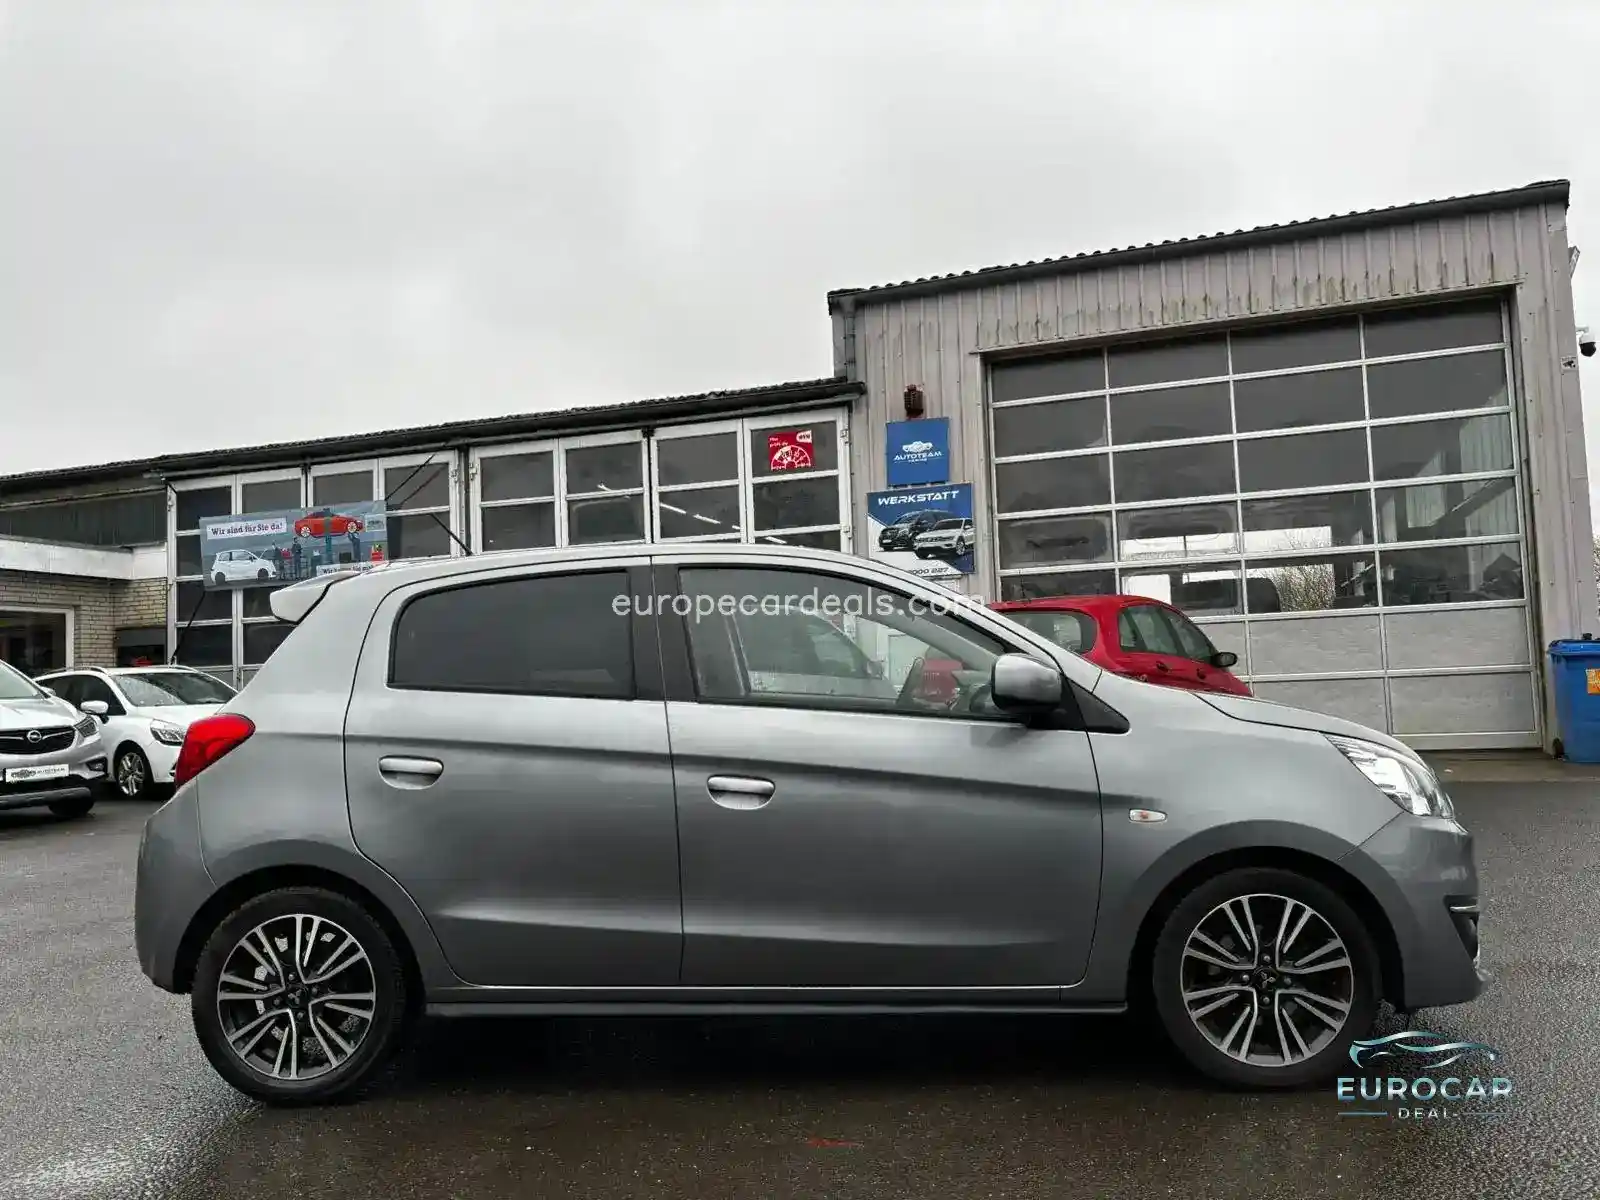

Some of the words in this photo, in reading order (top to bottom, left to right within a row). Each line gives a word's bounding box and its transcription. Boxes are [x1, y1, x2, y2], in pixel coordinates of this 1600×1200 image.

[893, 451, 943, 460] AUTOTEAM
[878, 490, 959, 506] WERKSTATT
[211, 527, 225, 535] Wir
[227, 525, 244, 534] sind
[257, 523, 269, 532] Sie
[270, 521, 283, 530] da!
